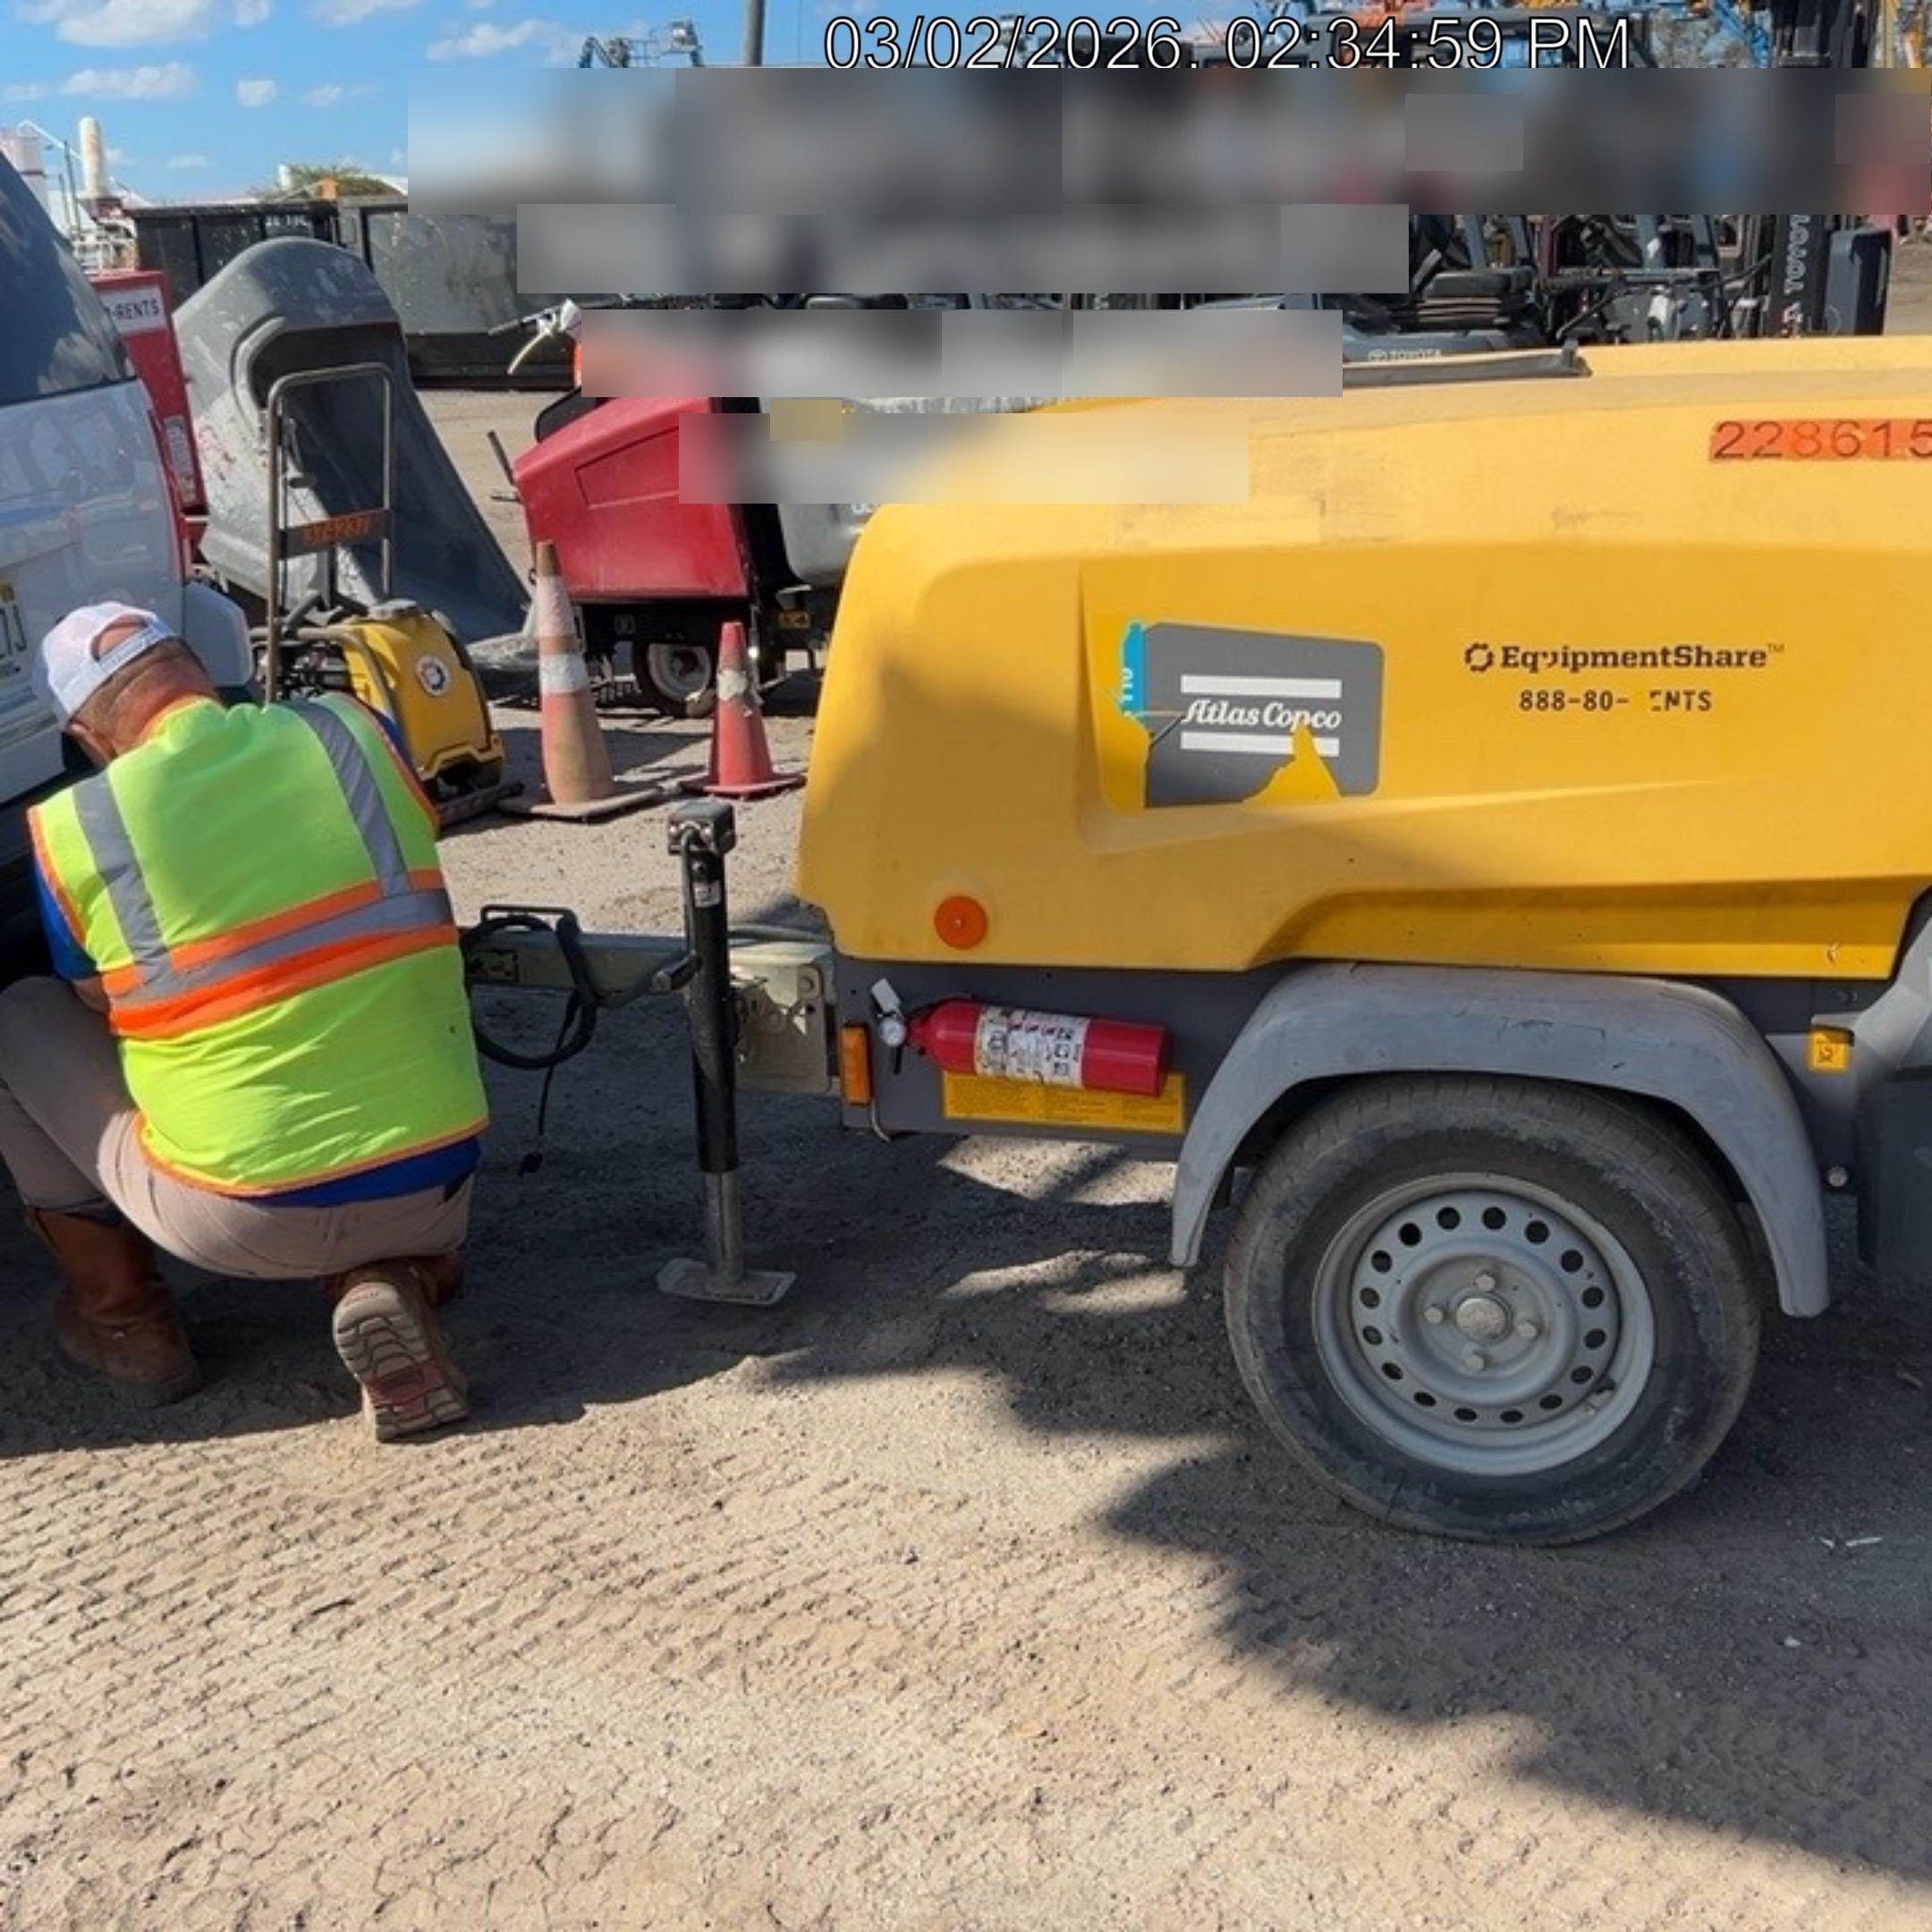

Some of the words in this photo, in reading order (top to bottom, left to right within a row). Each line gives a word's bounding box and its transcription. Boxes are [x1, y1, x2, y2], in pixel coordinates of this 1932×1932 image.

[1784, 215, 1809, 296] TOYOT
[1713, 419, 1932, 460] 228615
[1180, 699, 1259, 726] Atlas
[1263, 701, 1342, 733] Copco
